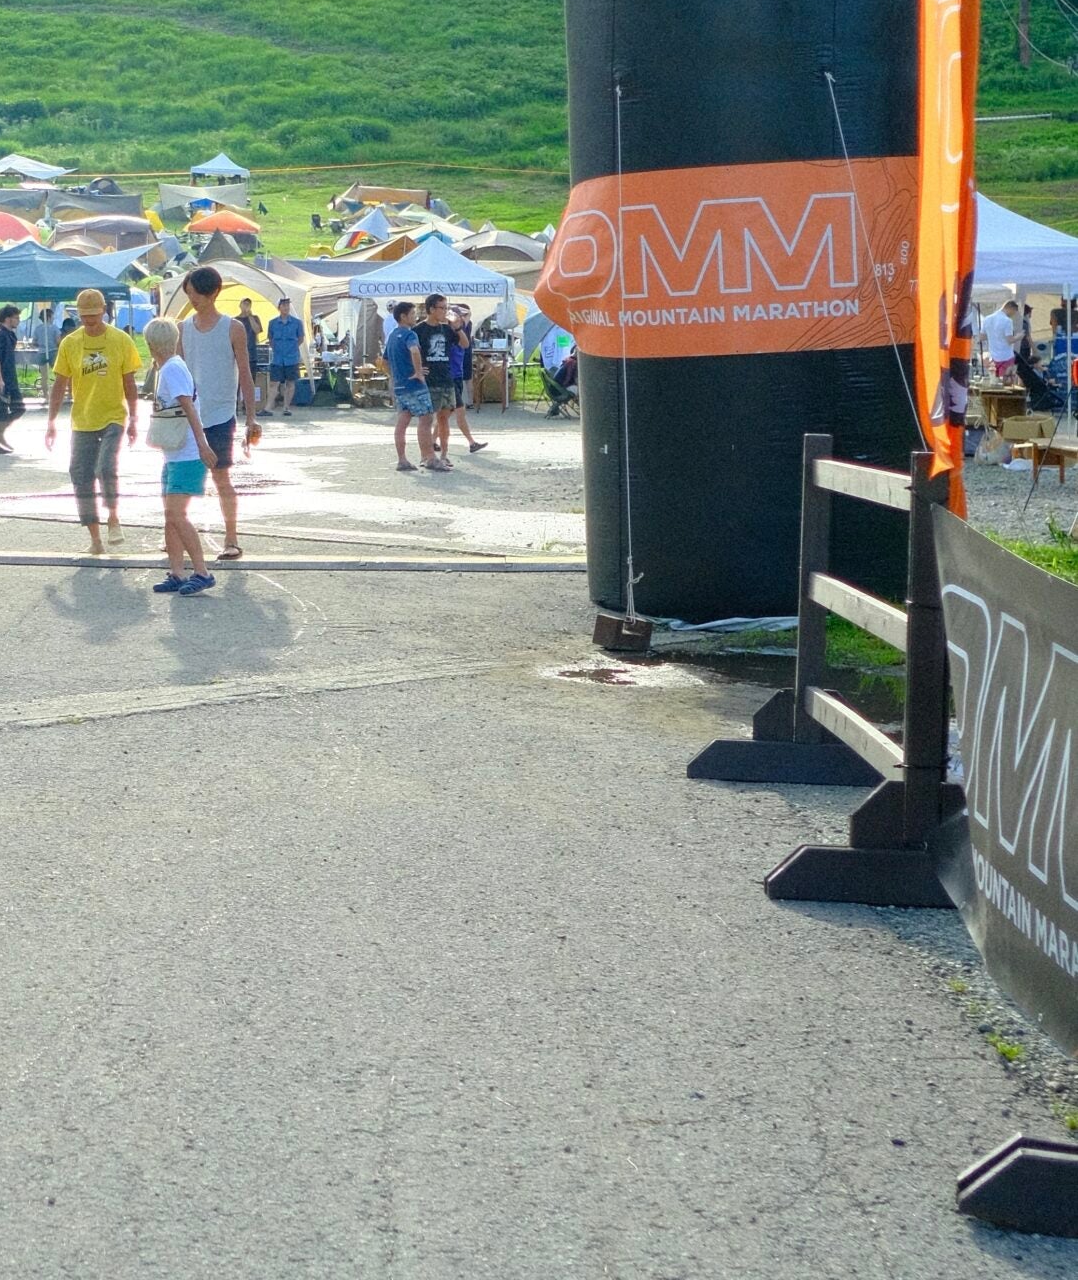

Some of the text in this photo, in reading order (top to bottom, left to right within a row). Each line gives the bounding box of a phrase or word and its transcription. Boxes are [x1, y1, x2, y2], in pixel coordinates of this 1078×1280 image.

[546, 192, 859, 301] OMM
[874, 263, 895, 277] 813
[358, 282, 499, 294] COCO FARM & WINERY
[567, 299, 860, 328] RIGINAL MOUNTAIN MARATHON
